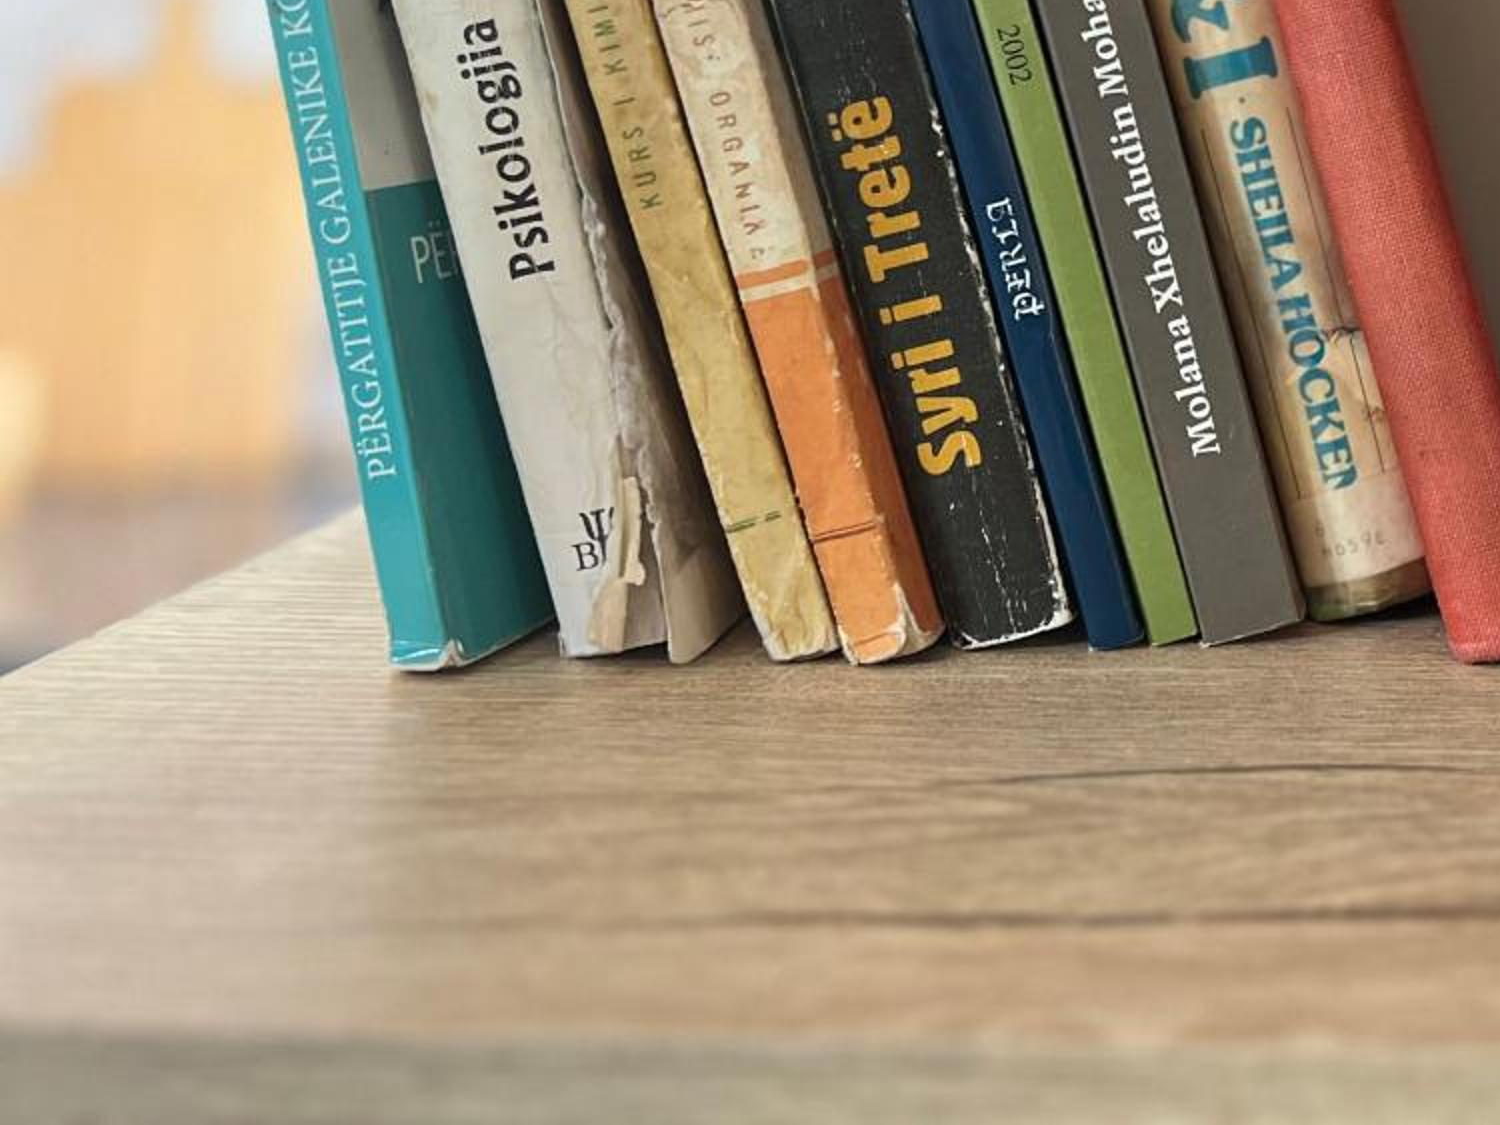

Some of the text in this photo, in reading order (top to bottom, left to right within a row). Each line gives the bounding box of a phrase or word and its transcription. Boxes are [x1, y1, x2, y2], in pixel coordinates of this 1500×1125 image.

[612, 94, 636, 106] I
[996, 24, 1033, 86] 2002
[1184, 35, 1279, 101] I
[288, 46, 351, 244] GALENIKE
[456, 18, 555, 280] Psikologjia
[622, 126, 662, 211] KURS
[1109, 102, 1184, 313] Xhelaludin
[1229, 116, 1304, 295] SHEILA
[826, 95, 983, 476] Syri i Tretë
[985, 197, 1046, 321] PERLA
[328, 252, 397, 480] PËRGATITJE
[1167, 314, 1221, 458] Molana
